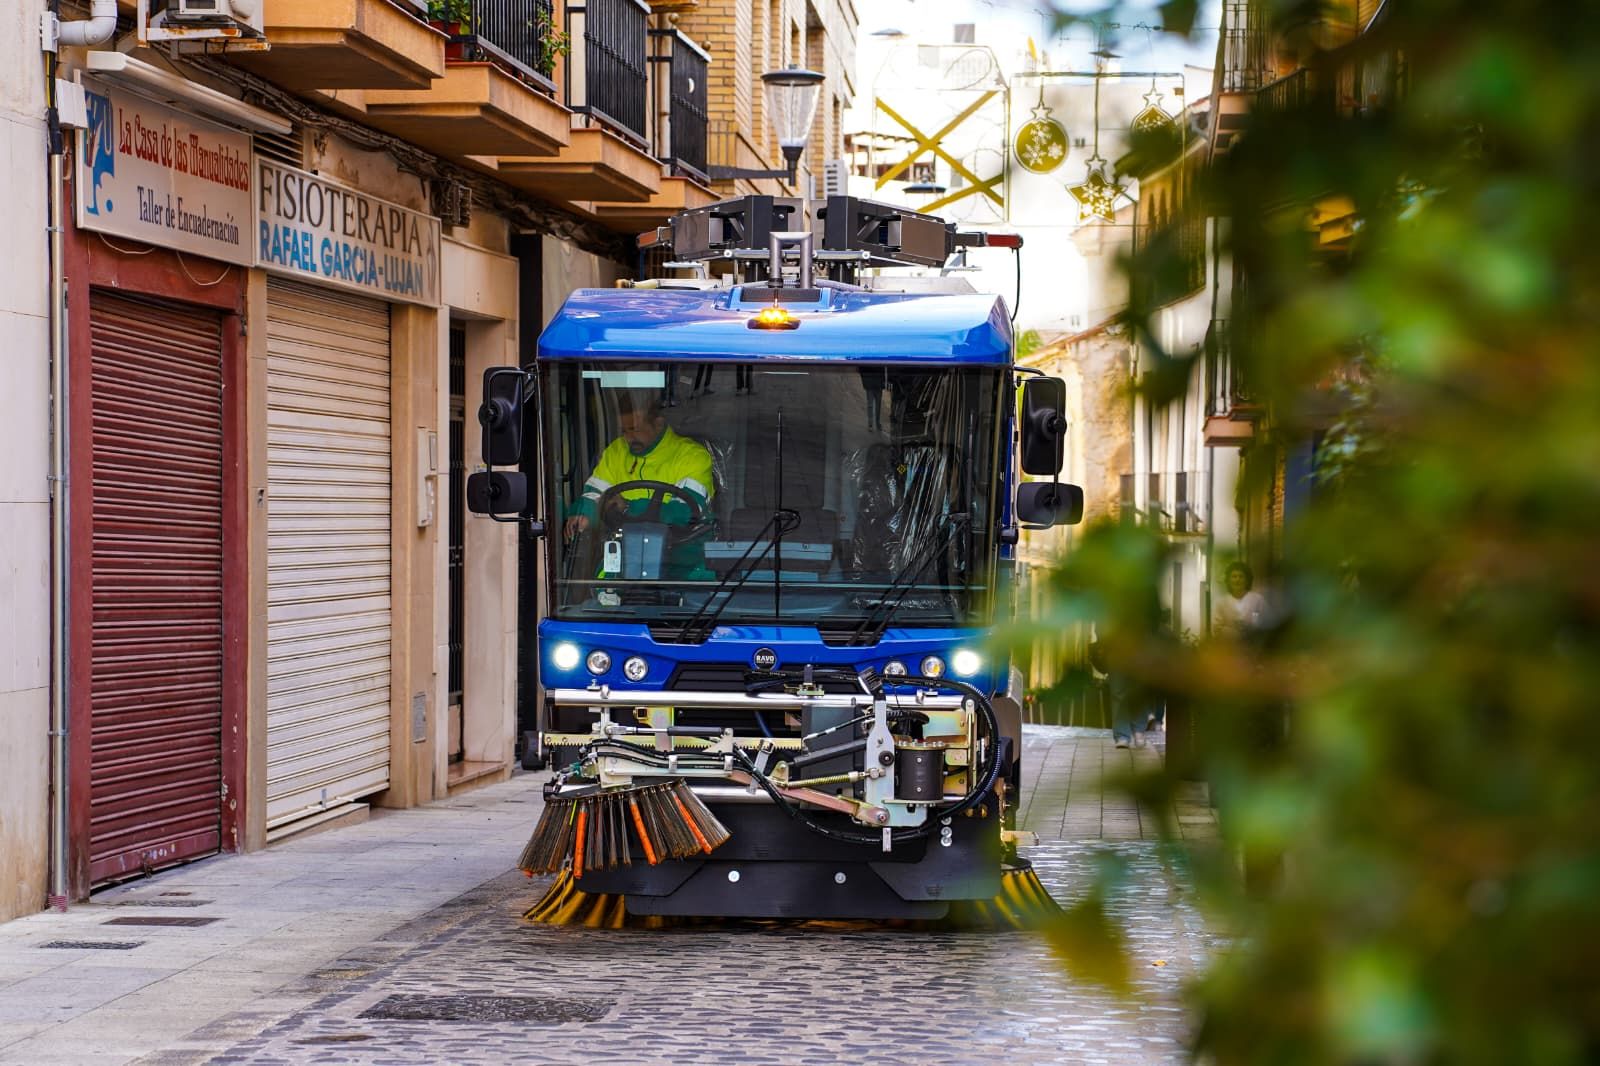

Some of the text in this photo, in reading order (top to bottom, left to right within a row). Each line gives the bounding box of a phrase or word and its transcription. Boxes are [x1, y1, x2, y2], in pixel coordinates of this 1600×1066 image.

[119, 108, 248, 192] La Casa de las Manualidades
[137, 185, 239, 246] Taller de Encuadernación
[259, 164, 422, 256] FISIOTERAPIA
[259, 220, 317, 273] RAFAEL
